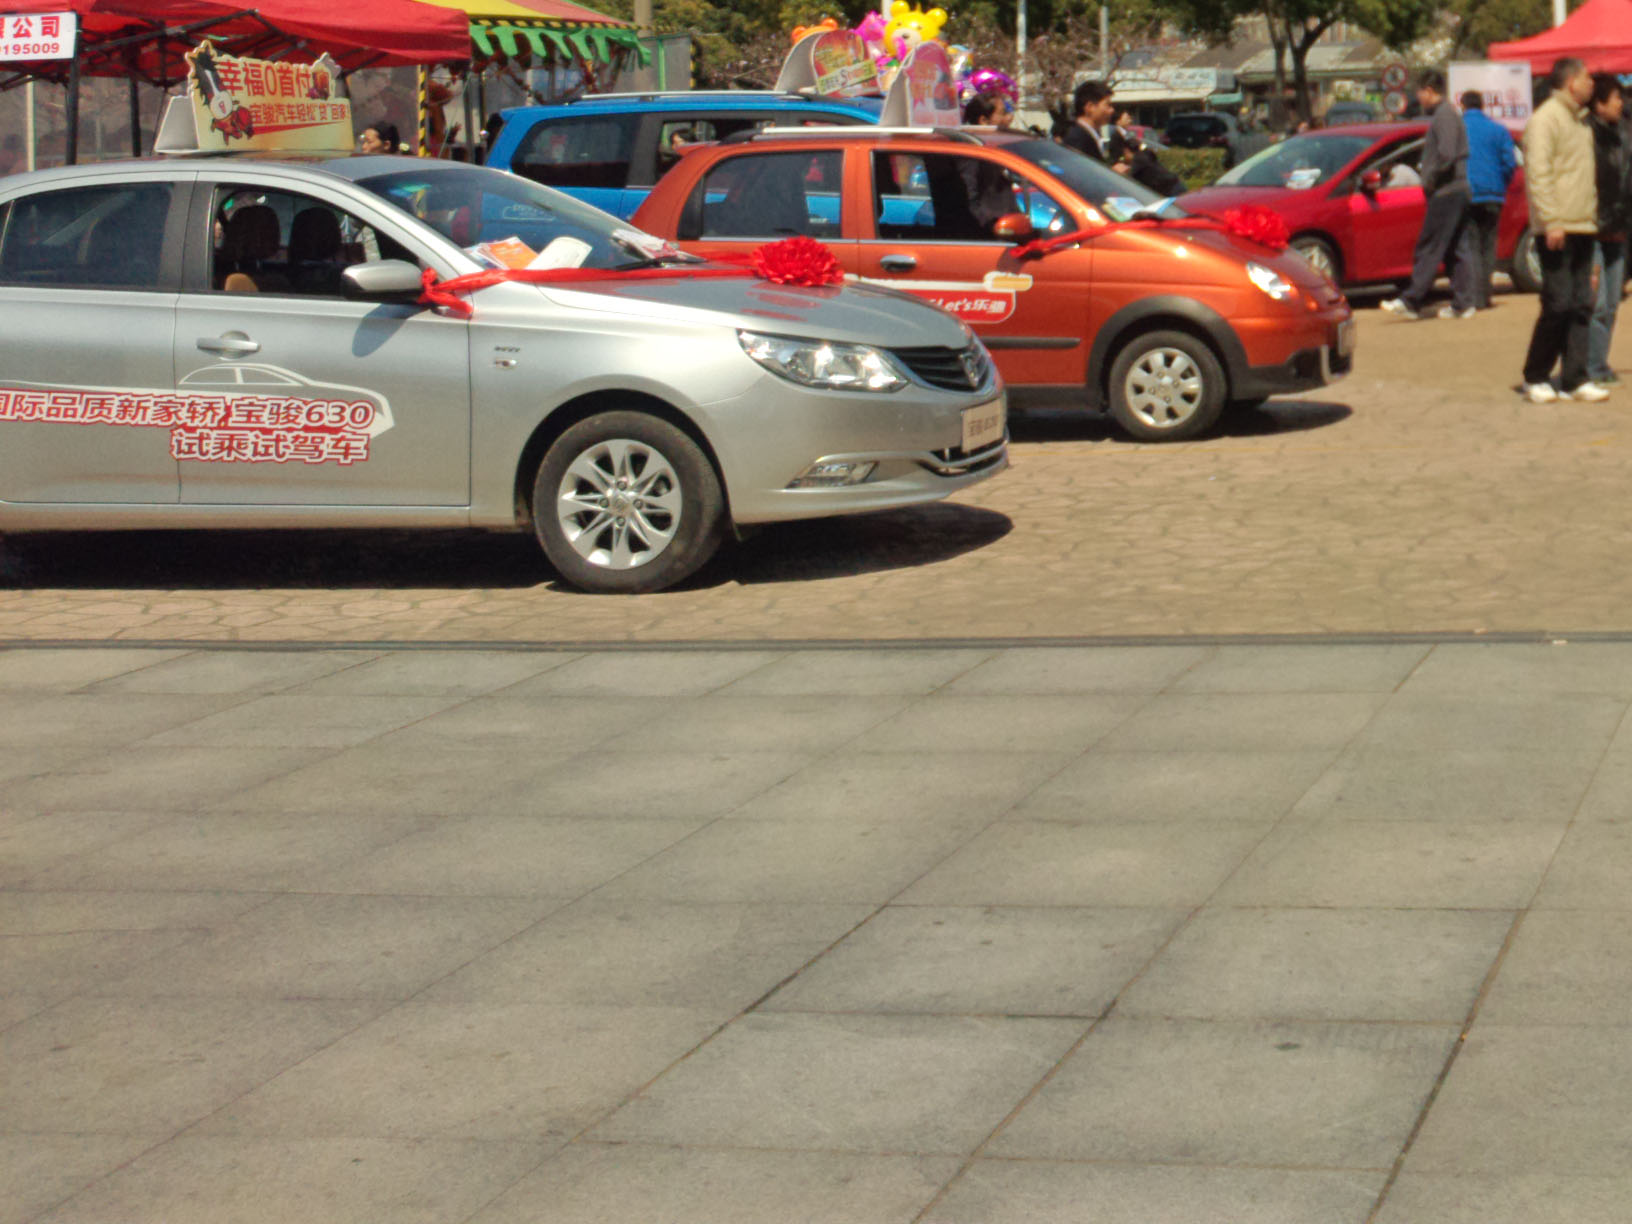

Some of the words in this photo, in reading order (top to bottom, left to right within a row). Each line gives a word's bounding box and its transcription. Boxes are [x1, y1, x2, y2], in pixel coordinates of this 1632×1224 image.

[0, 16, 59, 38] 公司
[0, 43, 60, 55] 195009
[234, 398, 374, 427] 宝骏630
[174, 431, 367, 462] 试乘试驾车
